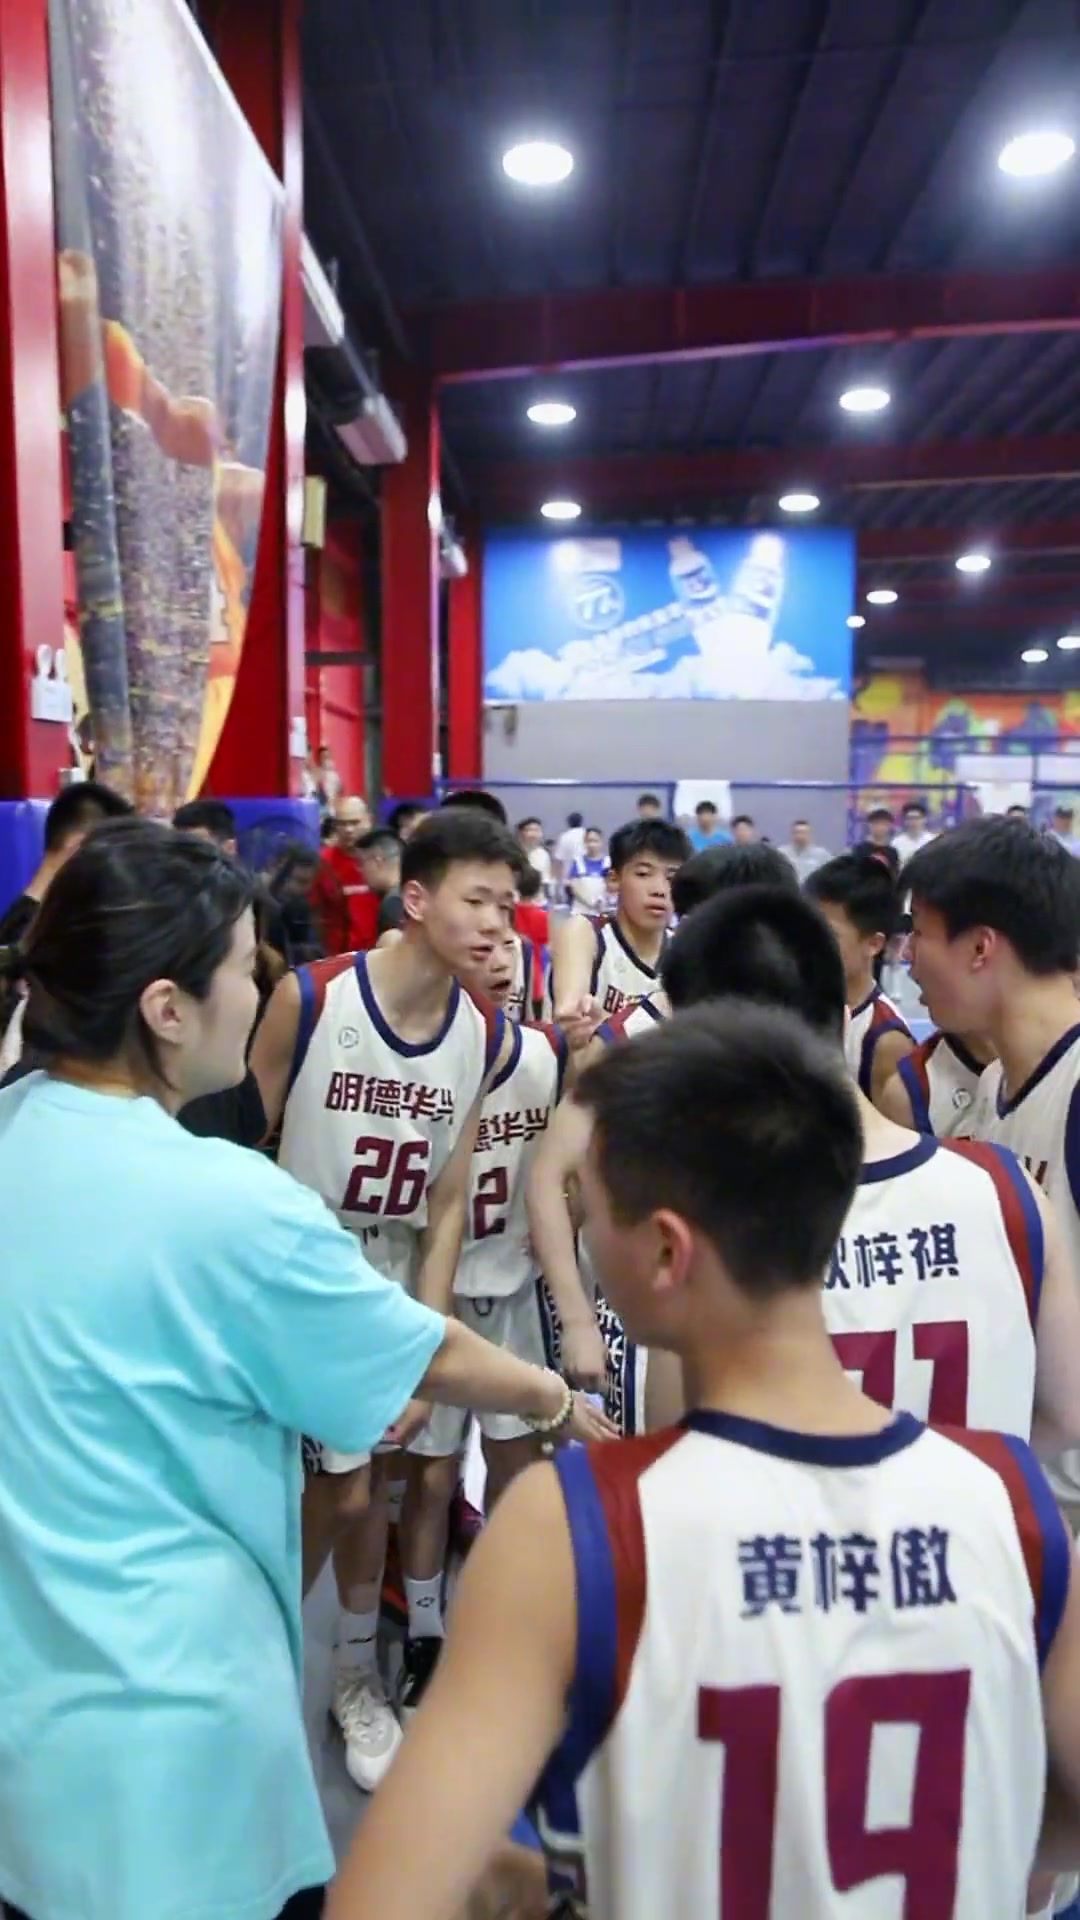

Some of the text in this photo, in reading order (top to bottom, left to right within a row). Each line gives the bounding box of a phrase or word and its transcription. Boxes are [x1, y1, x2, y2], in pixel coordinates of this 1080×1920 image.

[340, 1136, 429, 1215] 26
[473, 1166, 508, 1240] 2
[738, 1525, 957, 1620] 黄梓傲
[697, 1668, 972, 1920] 19
